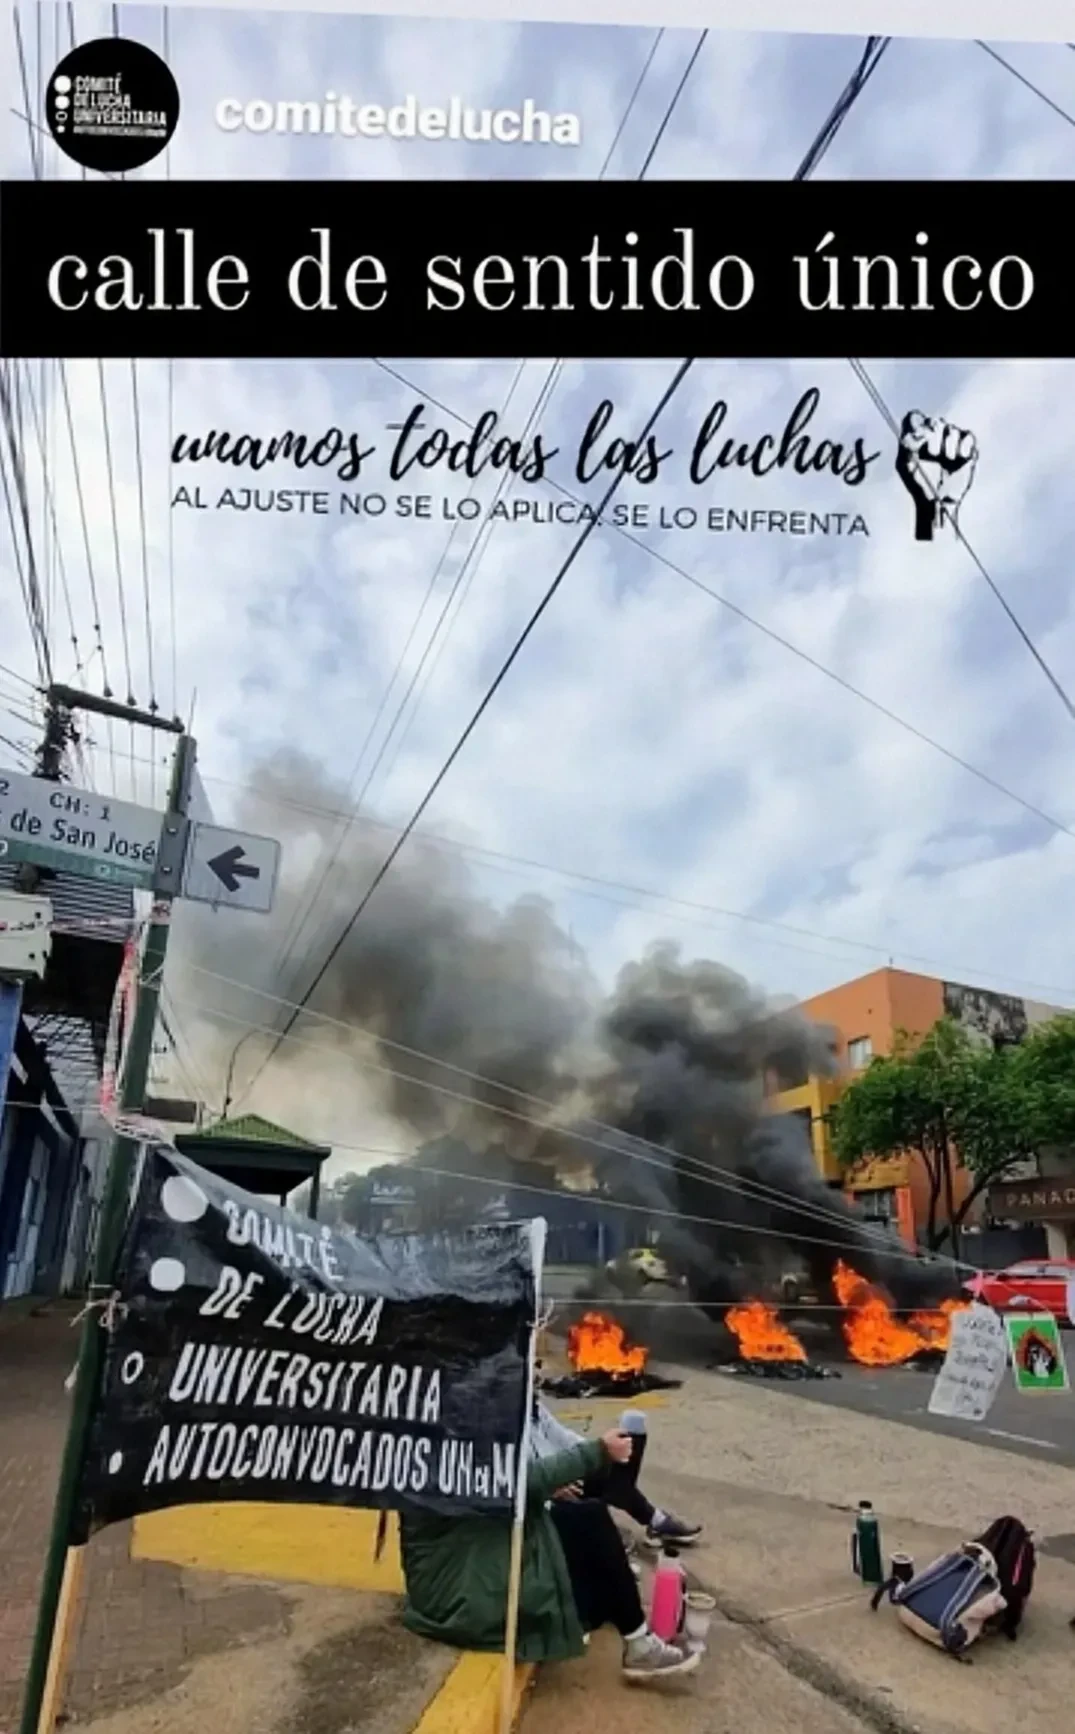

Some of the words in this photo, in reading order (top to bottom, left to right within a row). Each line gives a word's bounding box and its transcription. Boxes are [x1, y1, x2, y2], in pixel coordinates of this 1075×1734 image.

[10, 808, 42, 835] de
[50, 818, 96, 849] San
[103, 831, 156, 865] José
[199, 1265, 264, 1319] DE
[263, 1282, 384, 1346] LUCHA
[169, 1342, 441, 1423] UNIVERSITARIA
[143, 1424, 432, 1492] AUTOCONVOCADOS
[438, 1440, 518, 1499] UNaM
